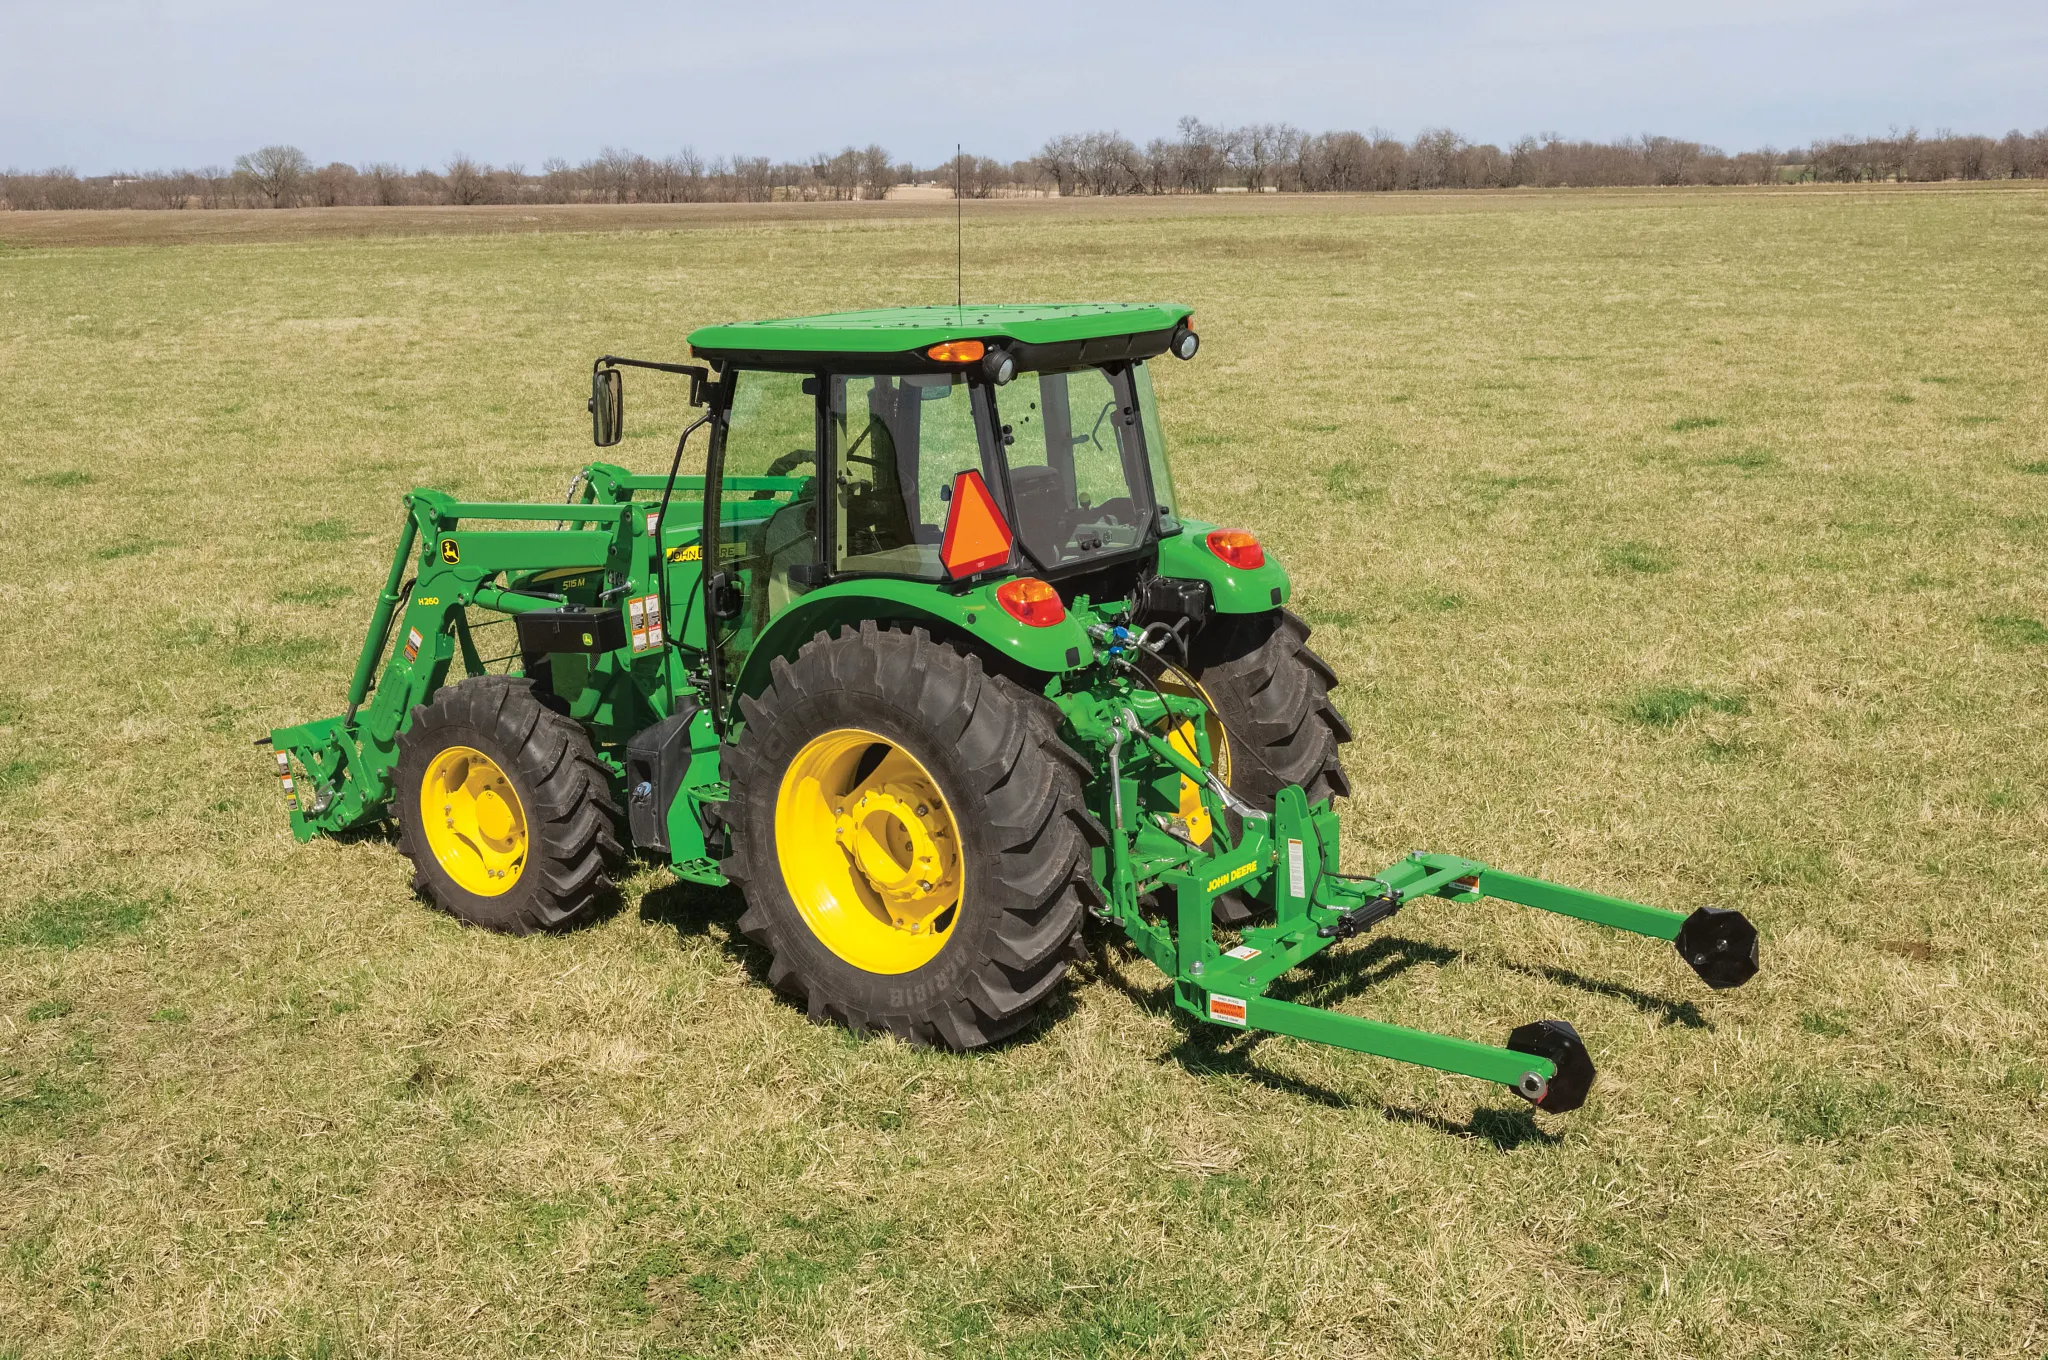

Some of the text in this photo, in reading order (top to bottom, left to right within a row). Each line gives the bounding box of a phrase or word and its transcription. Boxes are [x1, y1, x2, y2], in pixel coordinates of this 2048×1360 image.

[668, 550, 696, 560] JOHN
[417, 596, 440, 606] H260
[1206, 859, 1258, 893] JOHN DEERE
